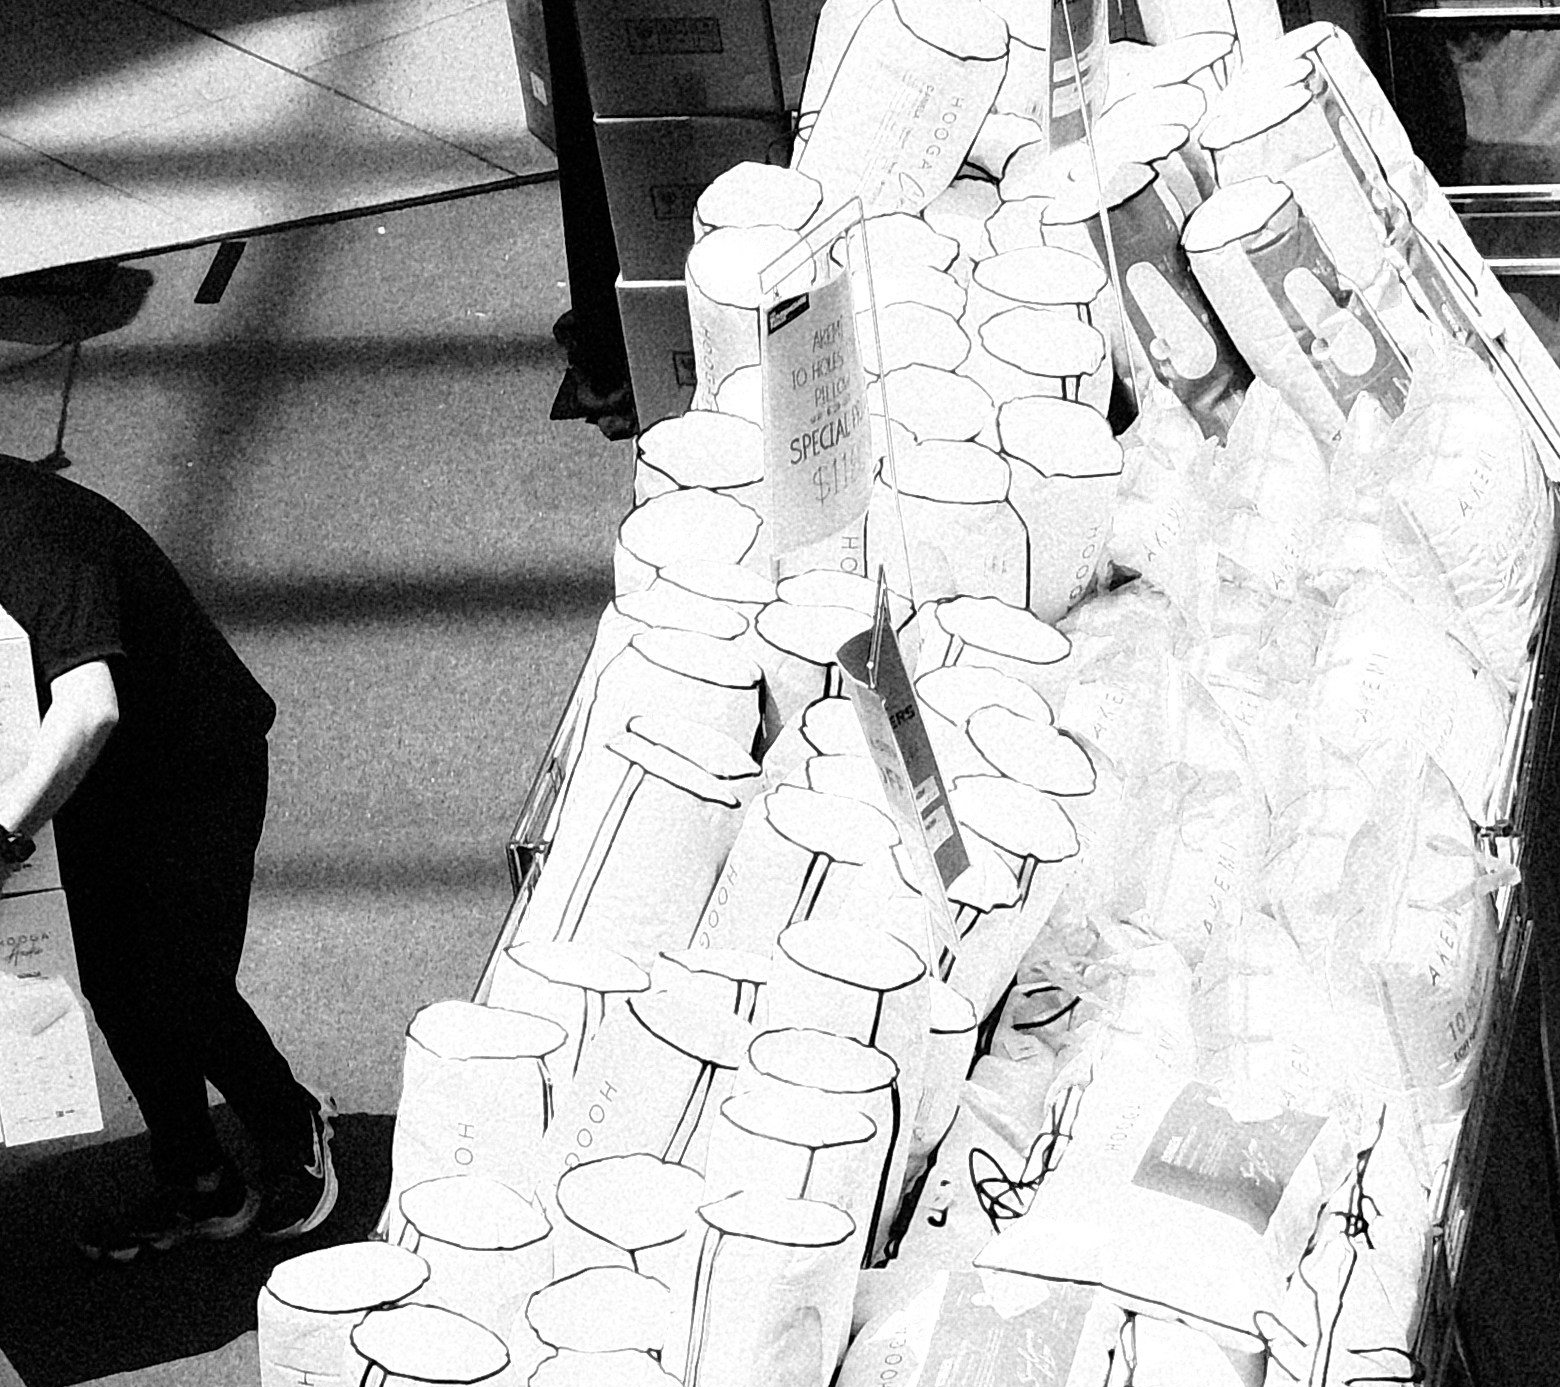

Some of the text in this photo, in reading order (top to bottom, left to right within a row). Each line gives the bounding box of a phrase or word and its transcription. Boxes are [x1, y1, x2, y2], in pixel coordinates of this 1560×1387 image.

[920, 98, 963, 170] HOOGA
[791, 367, 808, 390] 10
[790, 412, 850, 464] SPECIAL
